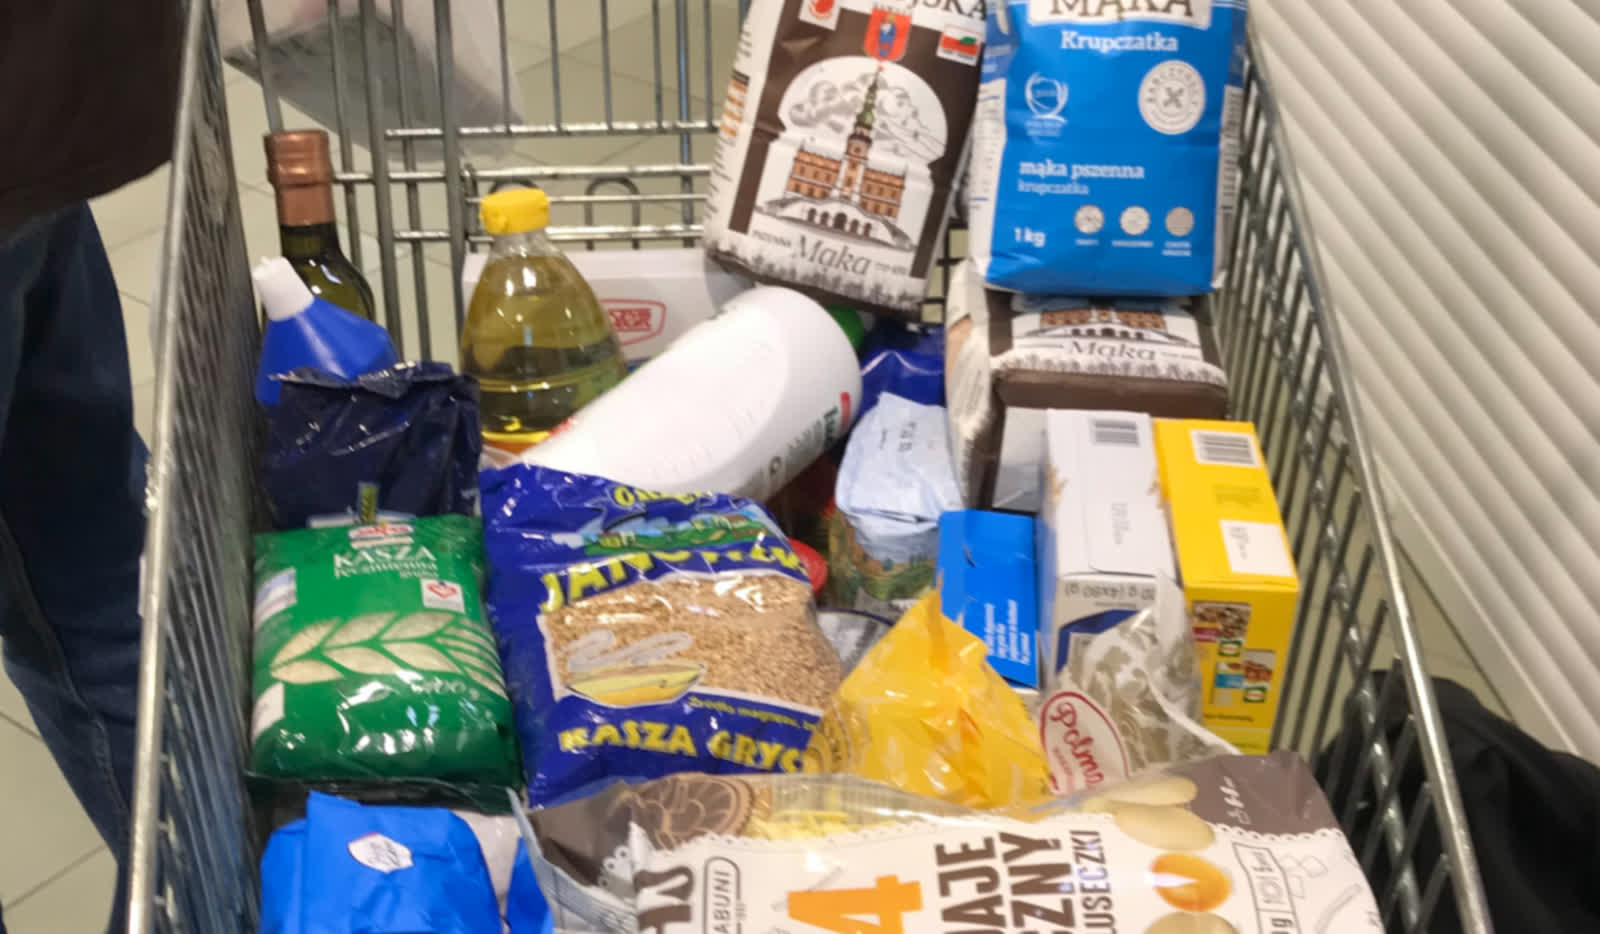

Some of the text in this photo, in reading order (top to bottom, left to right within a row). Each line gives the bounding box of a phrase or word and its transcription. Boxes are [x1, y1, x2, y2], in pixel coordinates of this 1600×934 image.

[1061, 30, 1179, 54] Krupczatka
[1071, 163, 1146, 181] pszenna
[1024, 227, 1047, 249] kg
[557, 719, 698, 757] KASZA
[934, 836, 1007, 934] AJE
[997, 831, 1076, 934] ZNY
[1069, 829, 1118, 934] USECZKI
